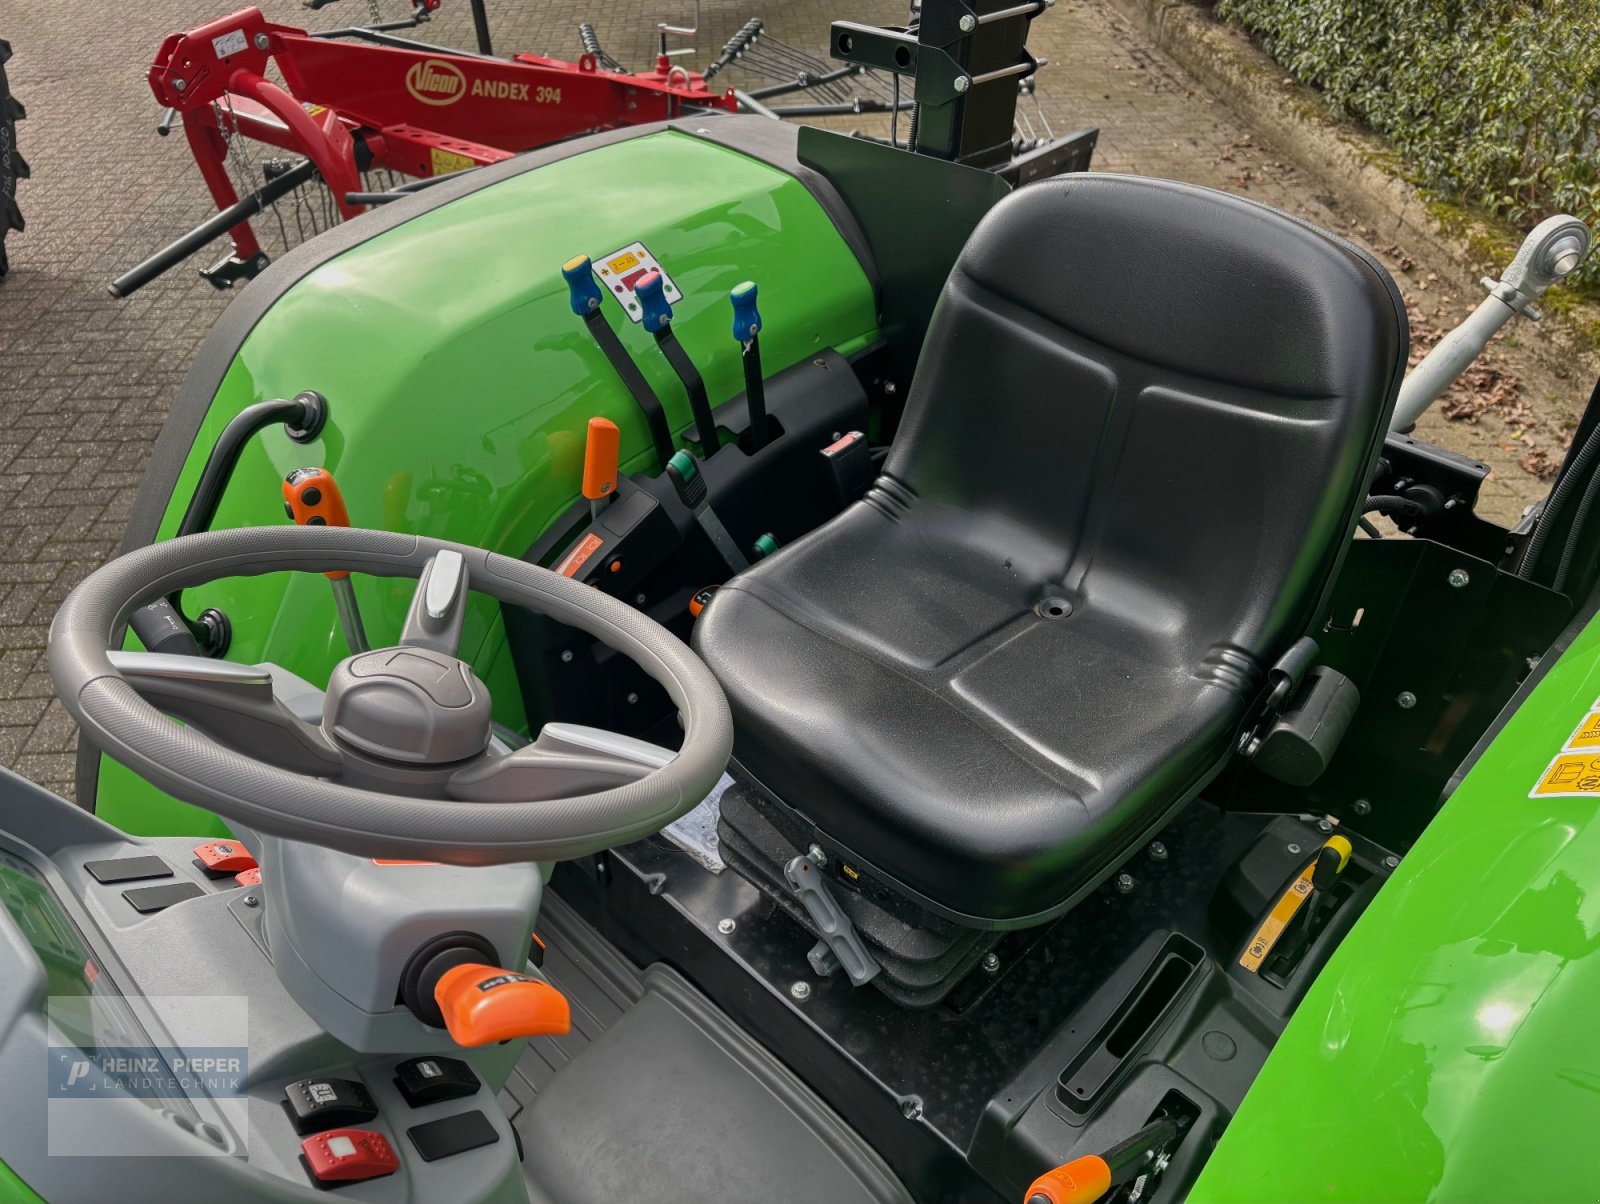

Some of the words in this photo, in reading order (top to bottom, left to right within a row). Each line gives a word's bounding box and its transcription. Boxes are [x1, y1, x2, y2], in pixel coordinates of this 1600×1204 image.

[415, 63, 460, 94] Vicon
[471, 79, 530, 101] ANDEX
[535, 86, 562, 104] 394
